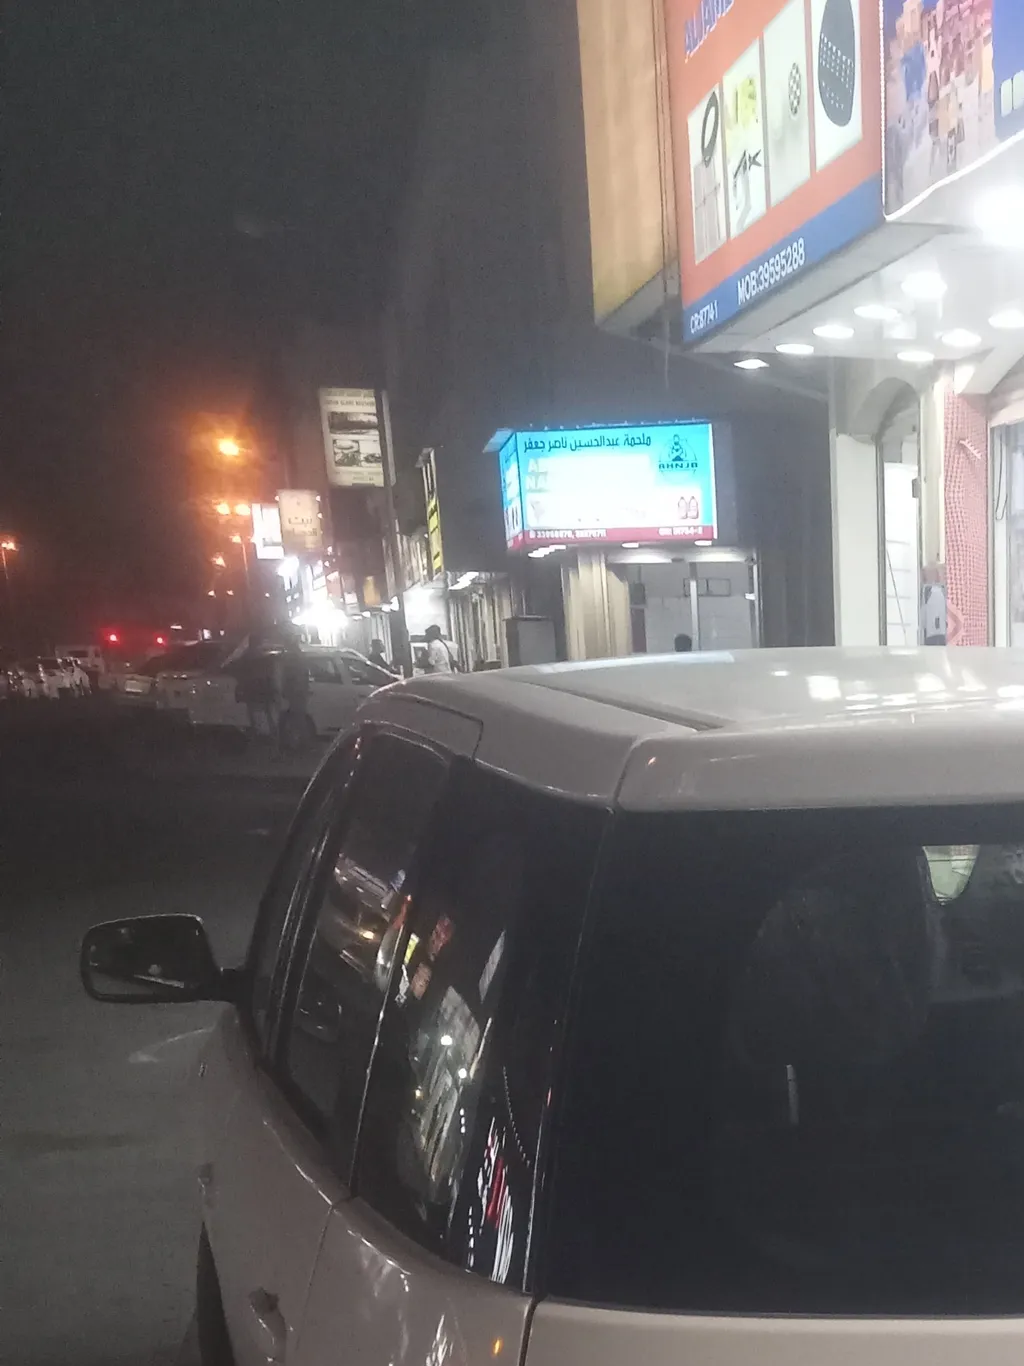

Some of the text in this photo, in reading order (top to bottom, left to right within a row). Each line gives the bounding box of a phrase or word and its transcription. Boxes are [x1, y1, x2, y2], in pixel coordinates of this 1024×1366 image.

[737, 237, 805, 306] MOB:39595288
[523, 437, 546, 453] جعفر
[547, 436, 568, 453] ناصر
[623, 433, 652, 448] ملحمة
